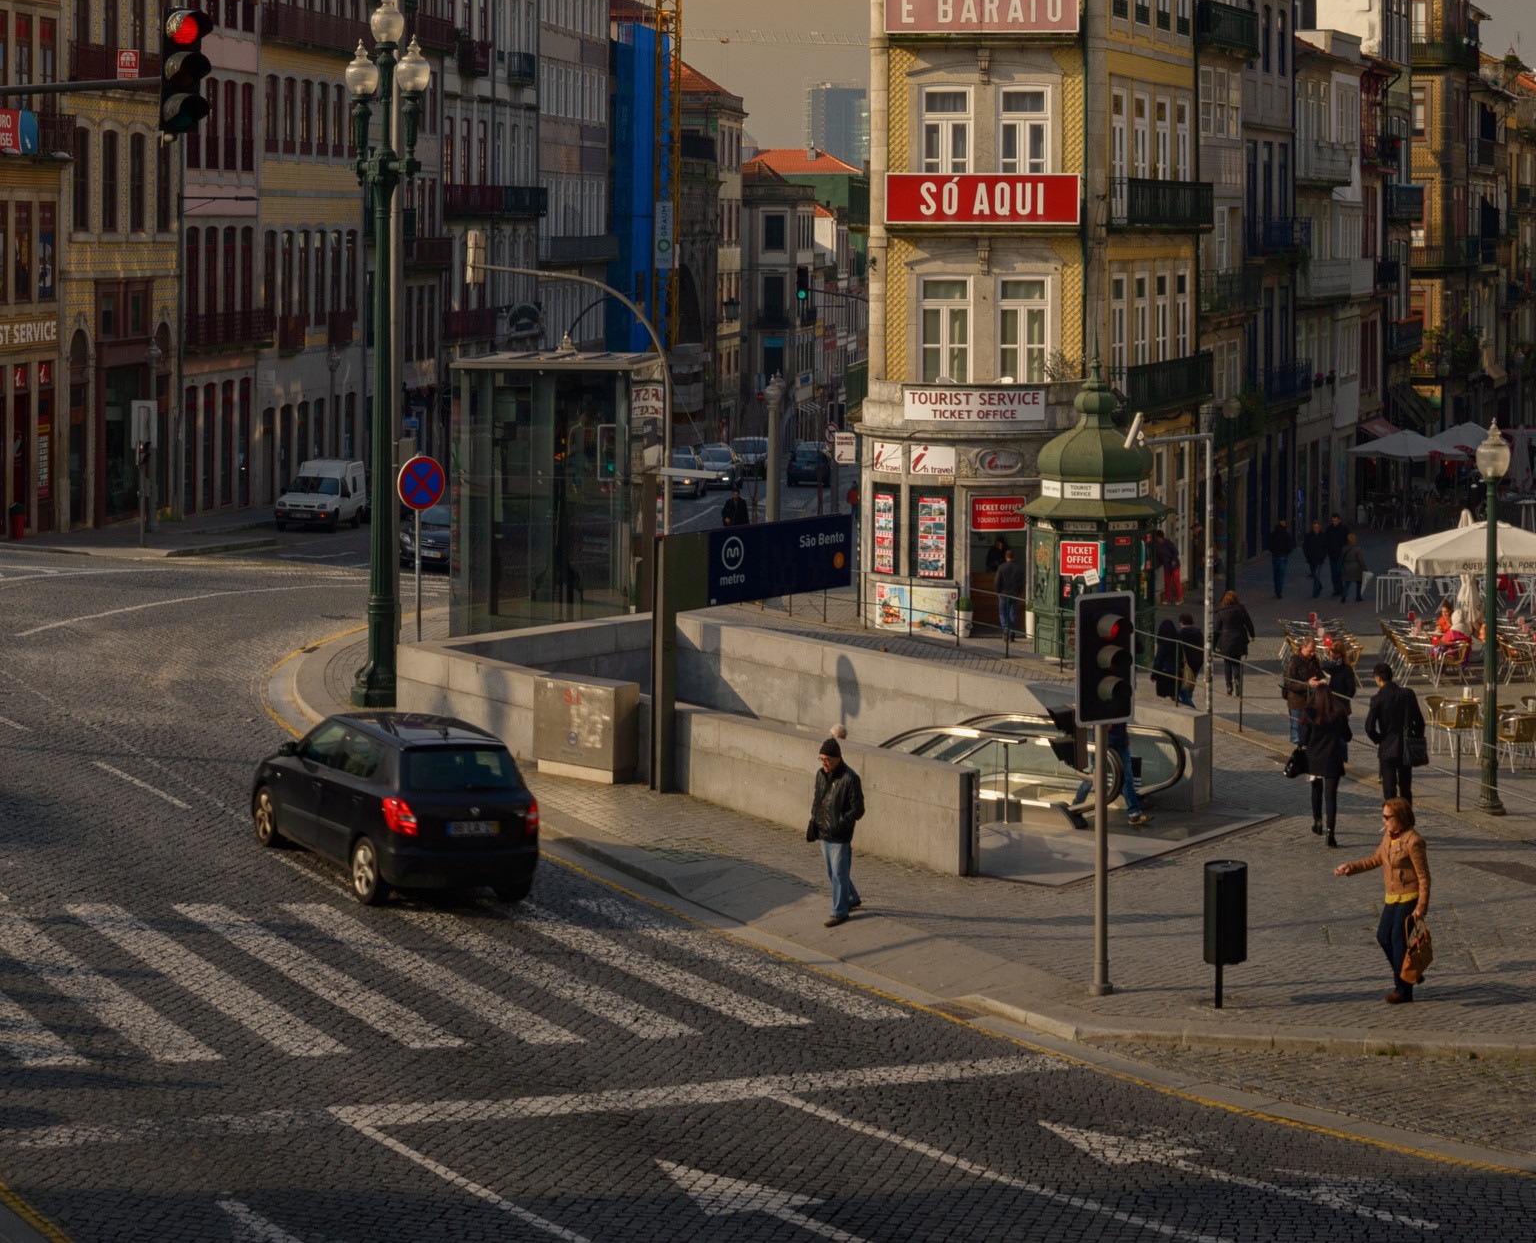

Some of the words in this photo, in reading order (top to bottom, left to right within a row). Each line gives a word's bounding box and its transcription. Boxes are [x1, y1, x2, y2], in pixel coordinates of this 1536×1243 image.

[920, 177, 960, 215] SÓ
[972, 181, 1044, 216] AQUI
[13, 320, 57, 344] SERVICE
[909, 392, 973, 406] TOURIST
[978, 392, 1040, 406] SERVICE
[931, 409, 974, 420] TICKET
[976, 409, 1017, 419] OFFICE
[885, 463, 901, 472] travel
[930, 465, 954, 475] travel
[975, 503, 999, 512] TICKET
[1001, 503, 1023, 511] OFFICE
[799, 534, 817, 548] São
[818, 531, 845, 546] Bento
[1066, 546, 1093, 555] TICKET
[1066, 555, 1093, 564] OFFICE
[719, 573, 746, 587] metro
